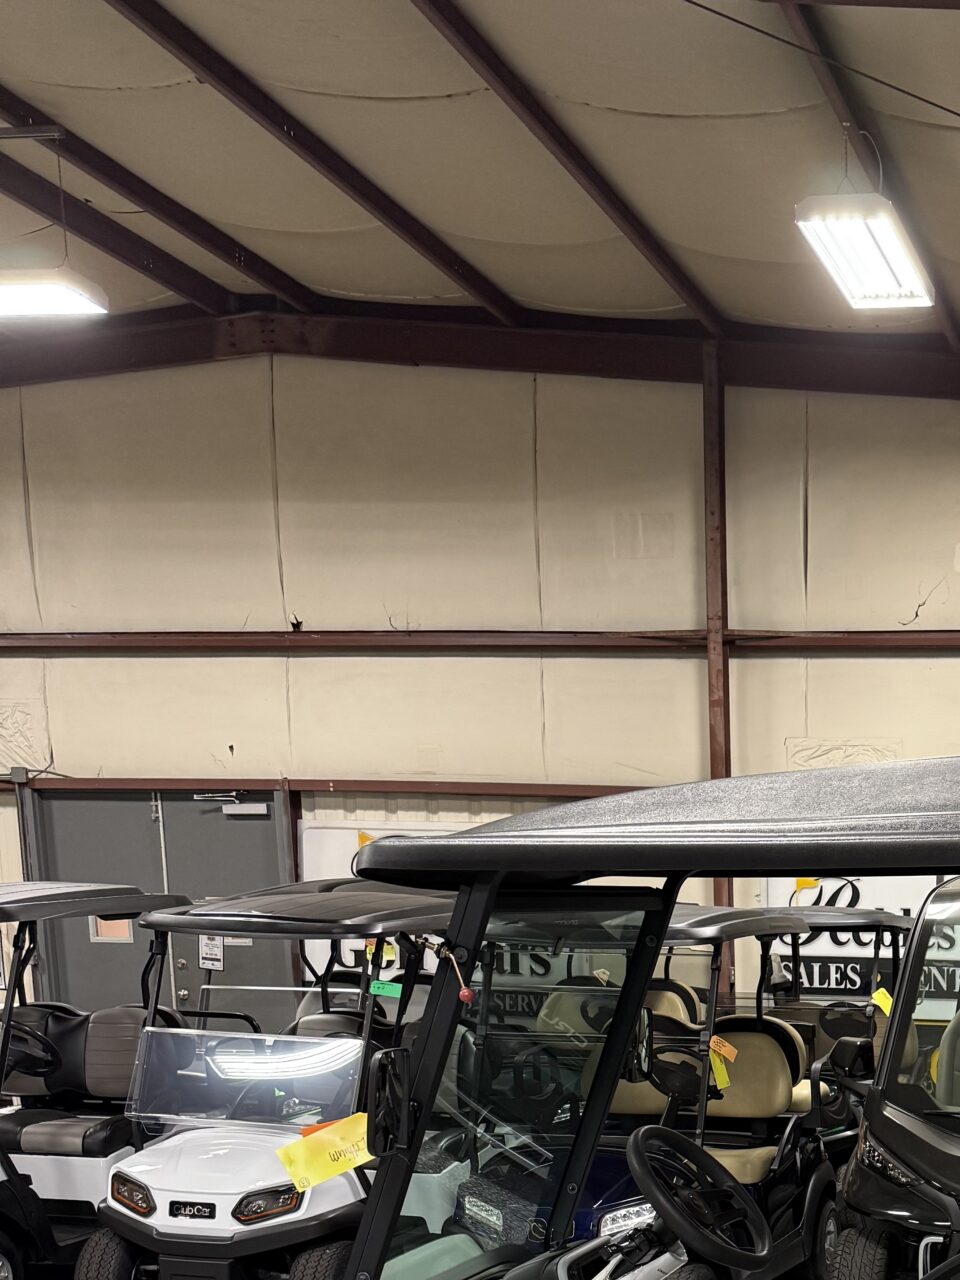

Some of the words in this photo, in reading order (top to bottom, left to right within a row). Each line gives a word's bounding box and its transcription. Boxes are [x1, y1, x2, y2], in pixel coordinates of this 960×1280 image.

[780, 961, 862, 990] SALES
[173, 1203, 193, 1216] Club
[194, 1204, 211, 1217] Car
